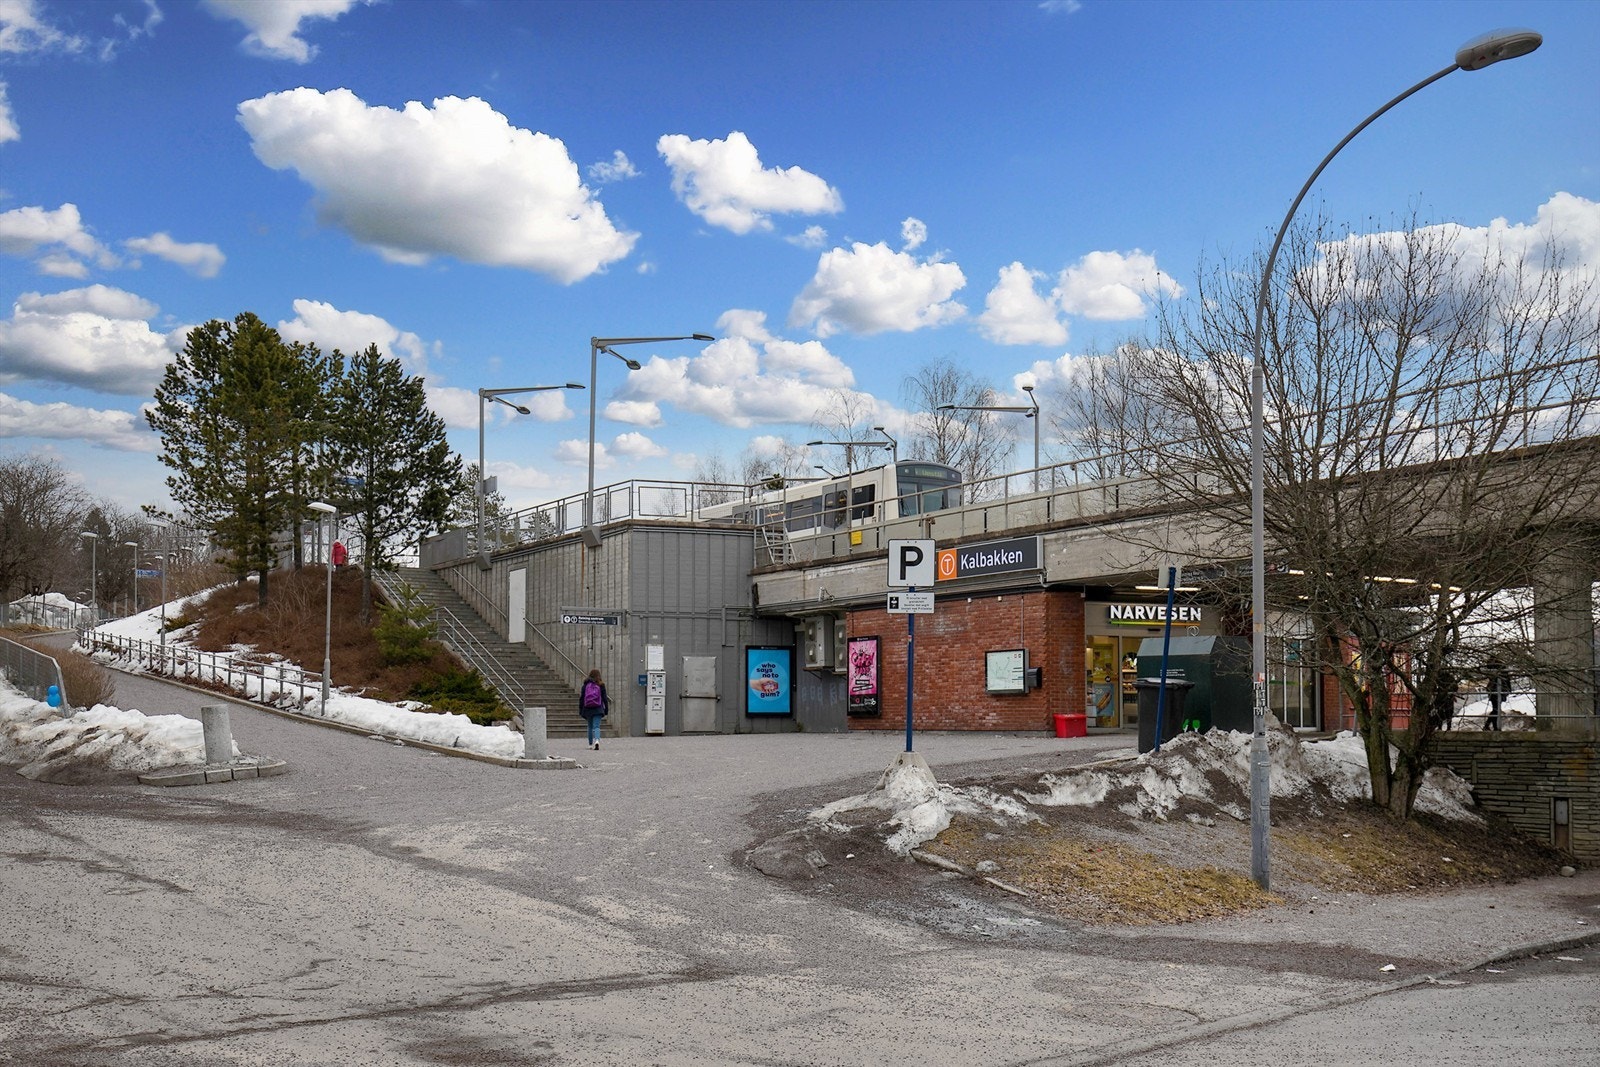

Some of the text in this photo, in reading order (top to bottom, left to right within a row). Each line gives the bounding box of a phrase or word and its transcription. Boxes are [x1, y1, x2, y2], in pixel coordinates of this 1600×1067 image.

[900, 545, 924, 580] P
[960, 549, 1023, 570] Kalbakken
[1110, 605, 1202, 621] NARVESEN
[756, 667, 773, 675] says
[760, 691, 781, 699] gum?
